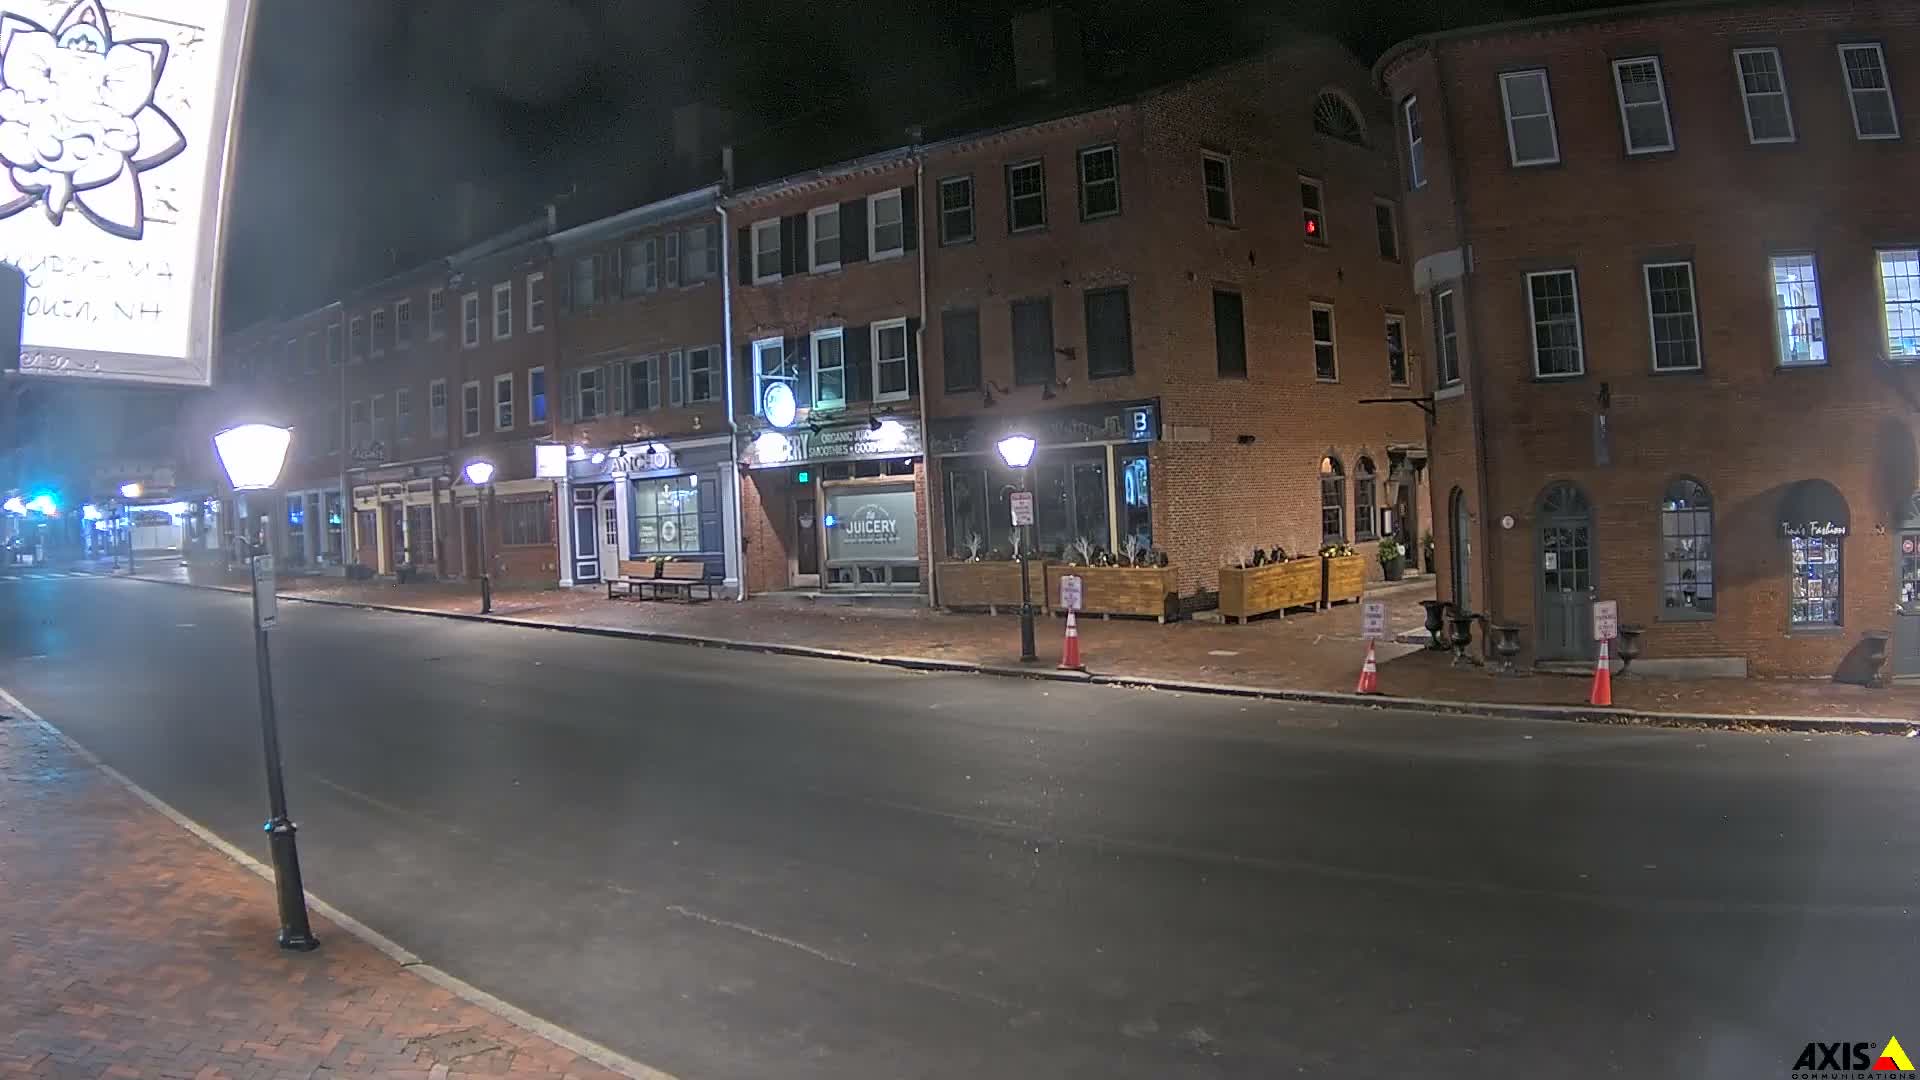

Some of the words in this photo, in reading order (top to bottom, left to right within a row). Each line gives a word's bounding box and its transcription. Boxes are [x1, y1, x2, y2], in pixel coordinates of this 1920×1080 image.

[821, 430, 853, 444] ORGANIC
[808, 443, 849, 457] SMOOTHIES
[846, 519, 897, 534] JUICERY
